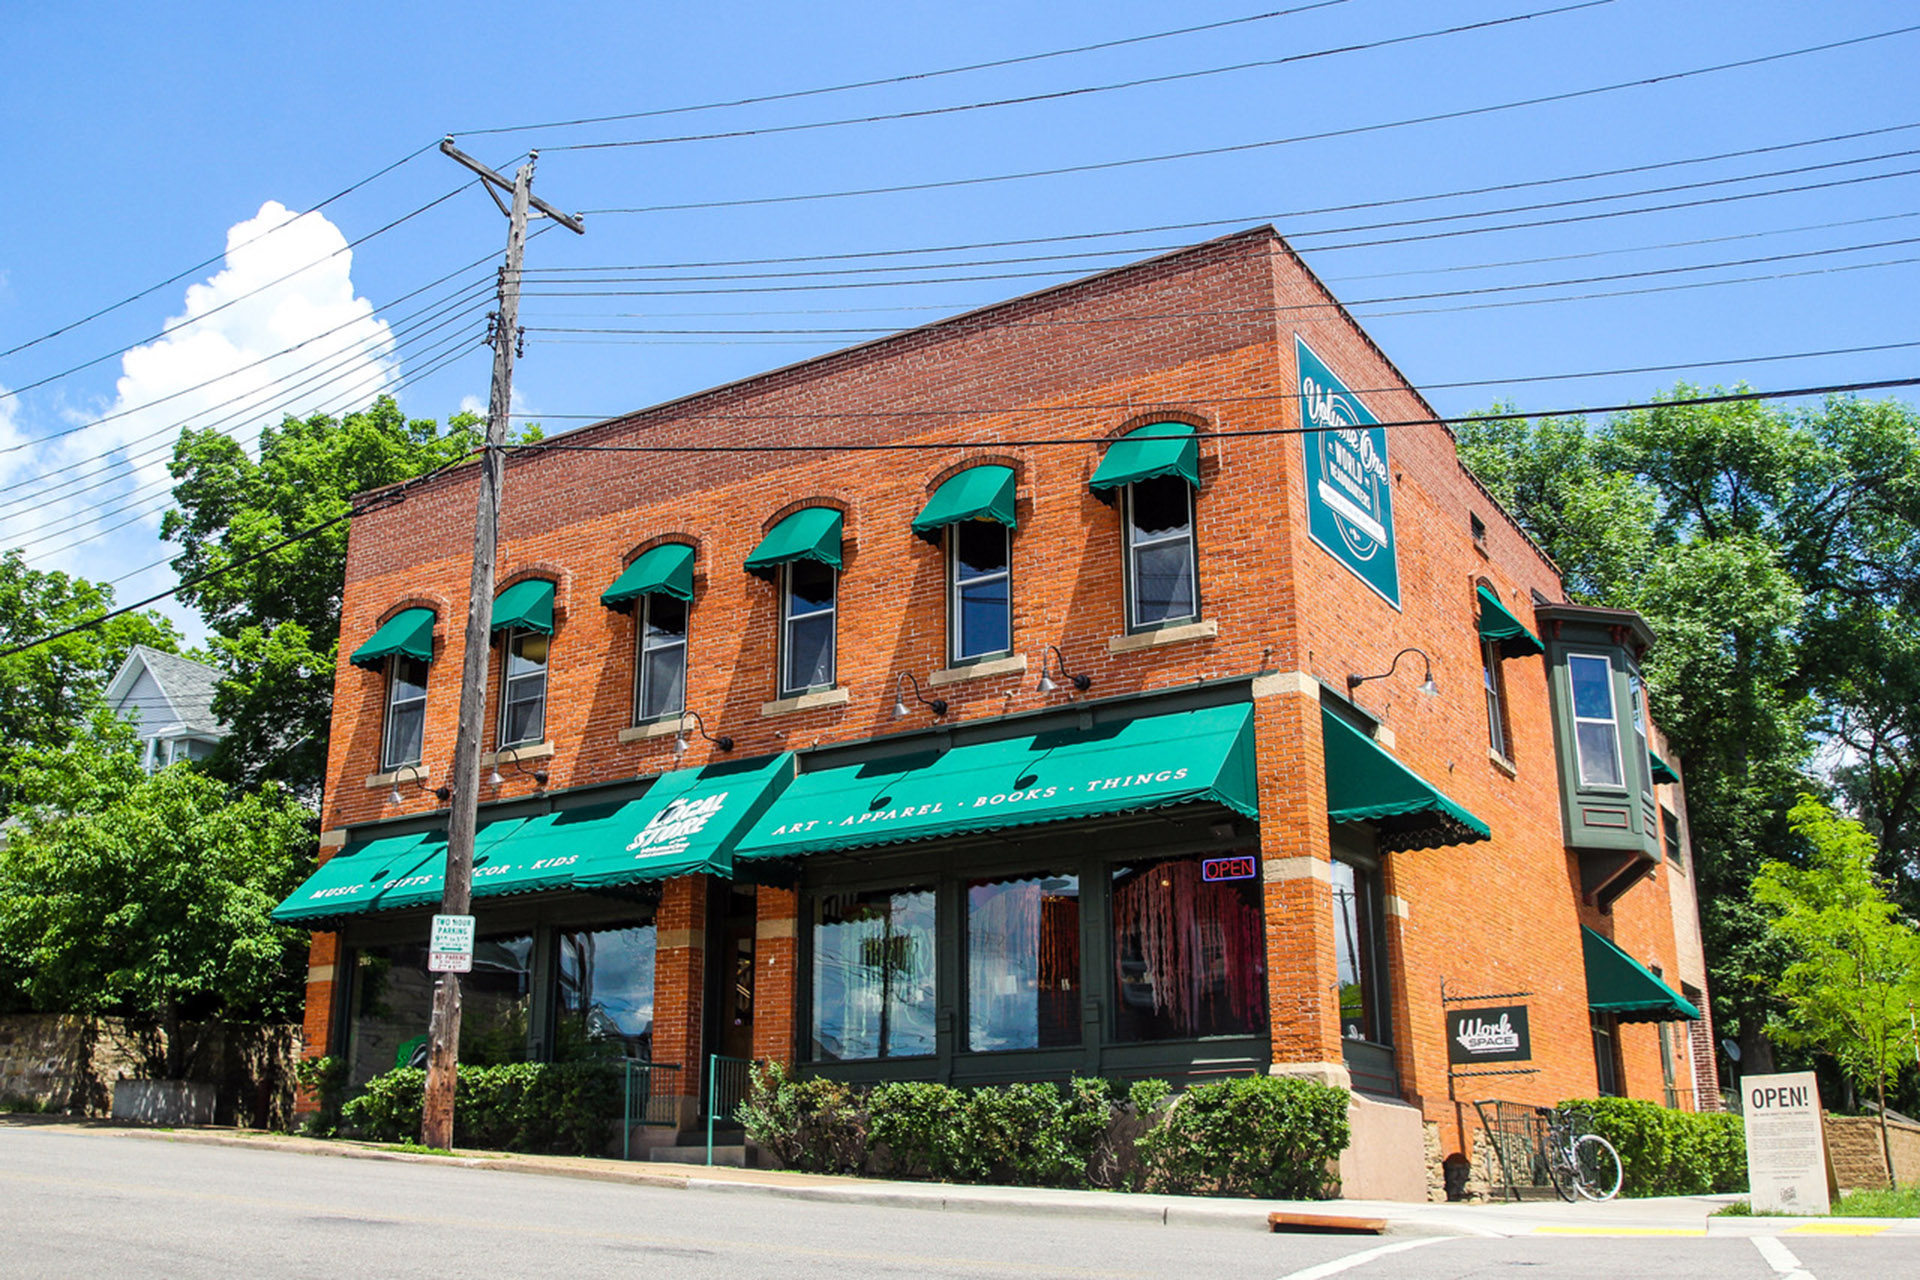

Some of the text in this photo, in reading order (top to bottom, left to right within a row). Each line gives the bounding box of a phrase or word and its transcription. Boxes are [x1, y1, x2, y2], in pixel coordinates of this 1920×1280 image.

[1303, 376, 1360, 451] Volume
[1360, 429, 1389, 485] One
[1334, 439, 1363, 485] WORLD
[644, 791, 729, 831] LOCAL
[770, 767, 1189, 836] ART APPAREL BOOKS THINGS
[625, 811, 716, 852] STORE
[309, 884, 364, 899] MUSIC
[383, 874, 433, 889] GIFTS
[530, 854, 579, 870] KIDS
[1205, 858, 1254, 879] OPEN
[436, 918, 450, 926] TWO
[438, 927, 467, 935] PARKING
[1458, 1012, 1514, 1037] Work
[1468, 1036, 1514, 1047] SPACE
[1751, 1086, 1809, 1109] OPEN!
